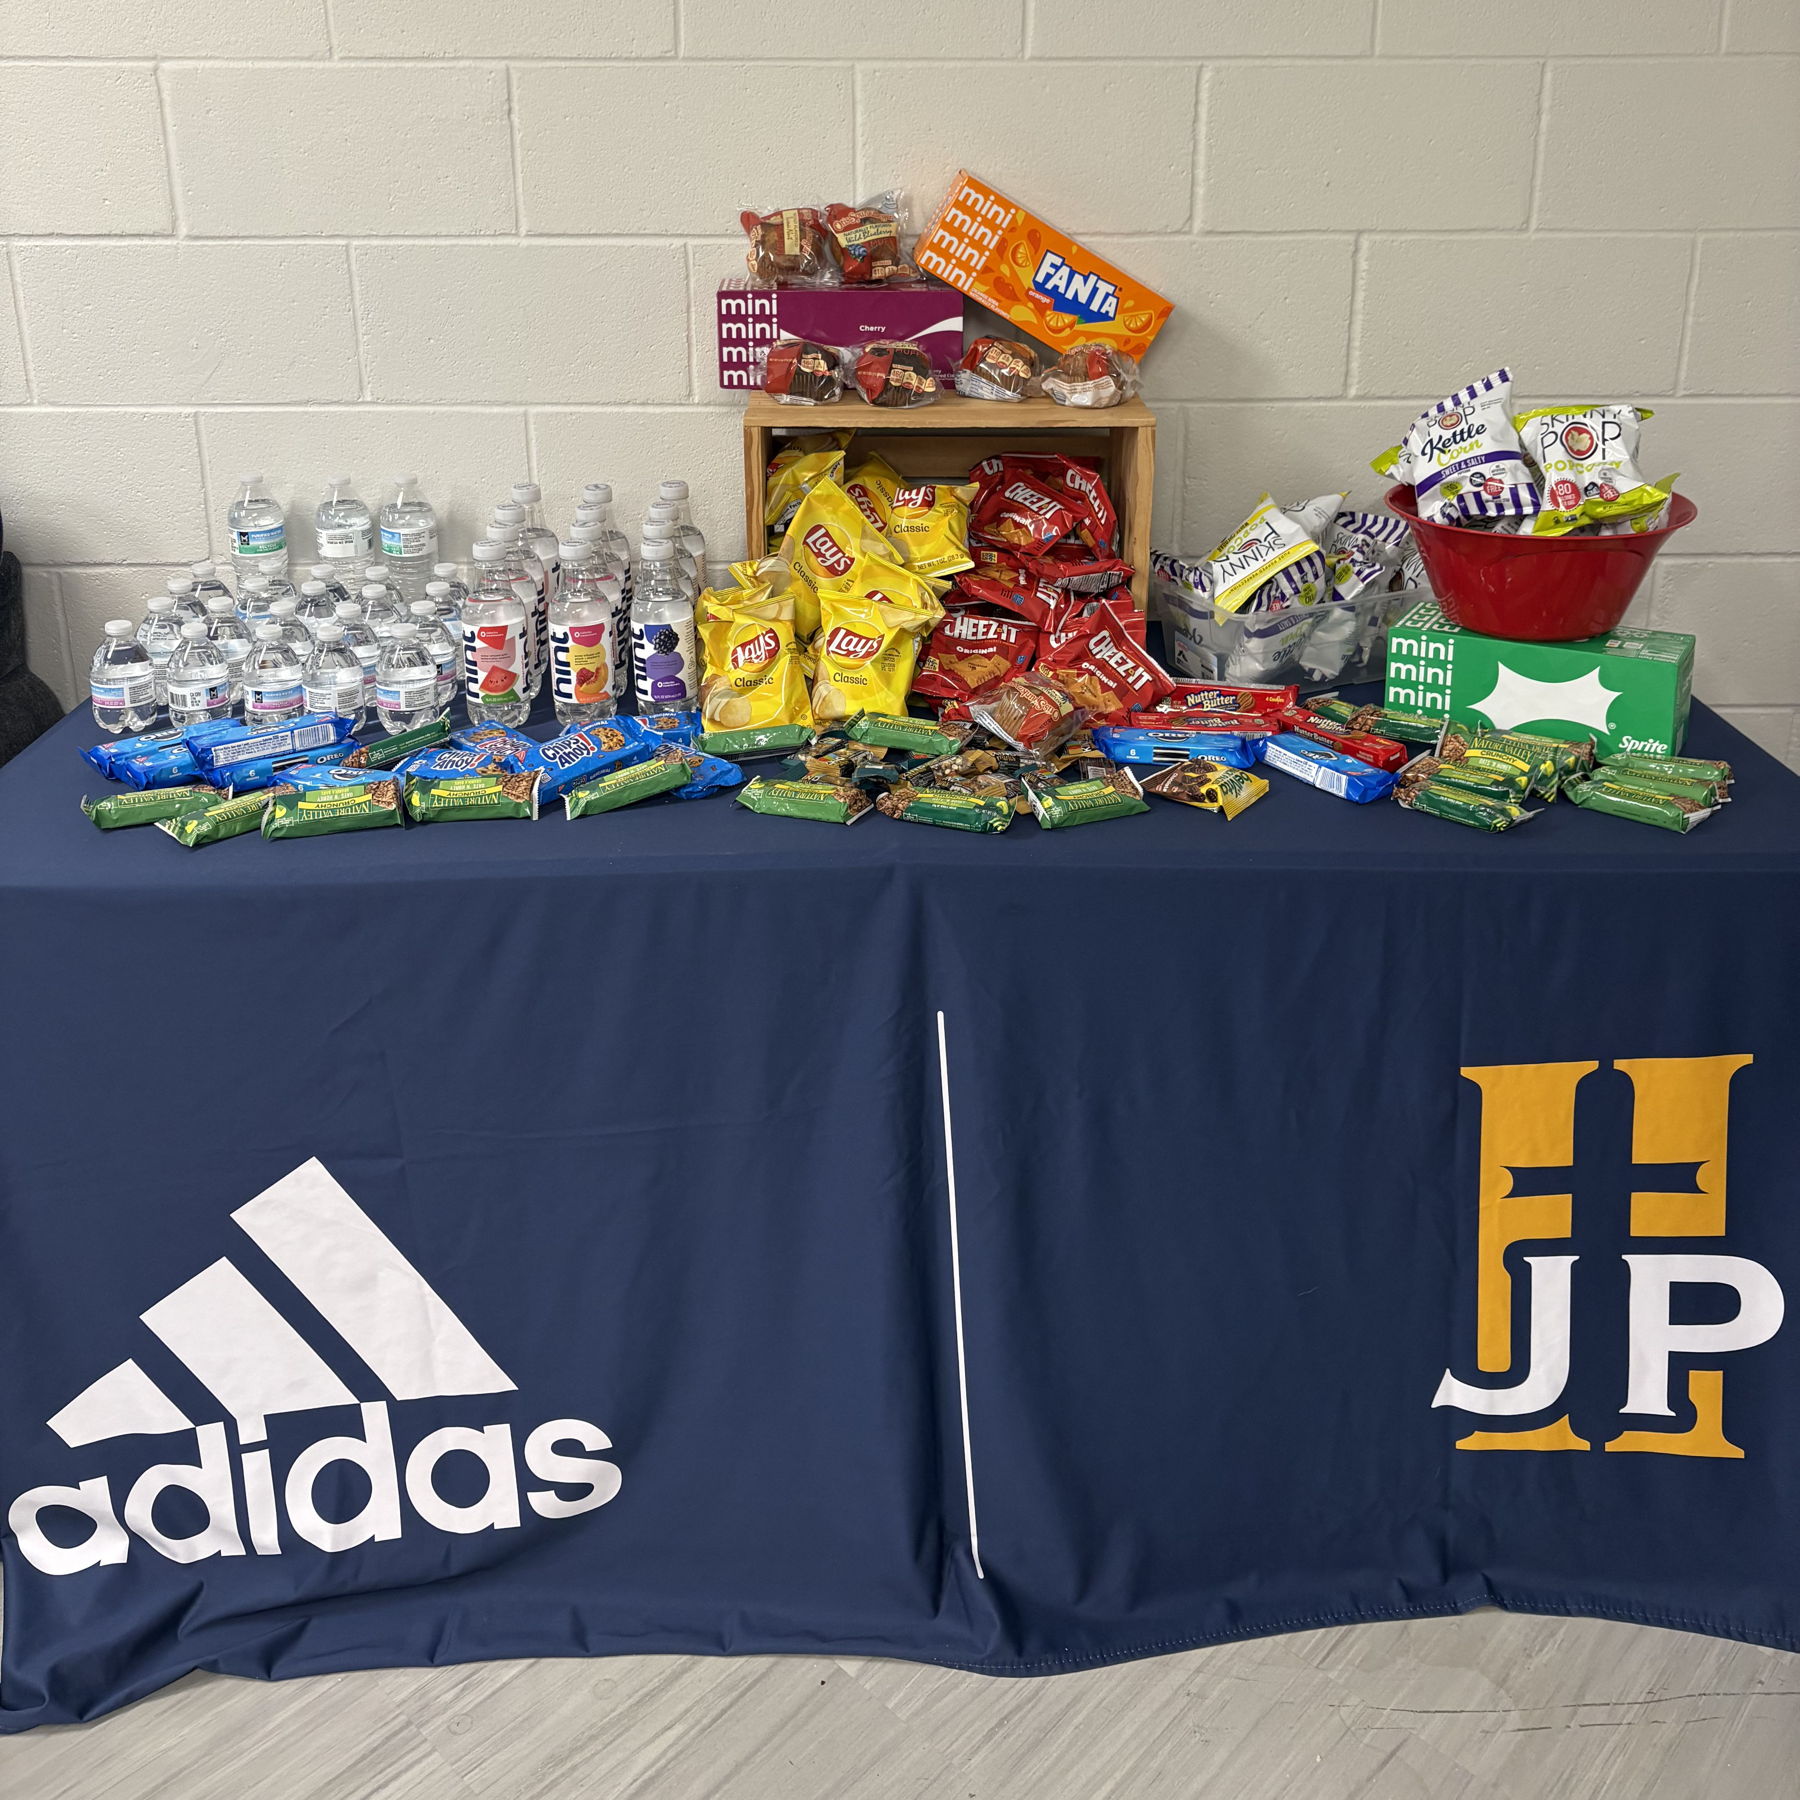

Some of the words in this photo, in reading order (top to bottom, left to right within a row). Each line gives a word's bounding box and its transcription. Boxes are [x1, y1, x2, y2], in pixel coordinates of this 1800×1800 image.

[958, 186, 1015, 228] mini
[945, 207, 1003, 250] mini
[932, 229, 990, 271] mini
[920, 250, 977, 292] mini
[1034, 251, 1118, 318] FANTA
[721, 293, 777, 315] mini
[1028, 290, 1051, 304] orange
[722, 318, 778, 339] mini
[859, 324, 886, 333] Cherry
[1421, 424, 1487, 463] Kettle
[1437, 439, 1483, 467] Corn
[1441, 463, 1460, 478] SWEET
[1467, 456, 1486, 467] SALTY
[893, 524, 930, 534] Classic
[805, 527, 851, 571] Lay's
[1220, 536, 1286, 583] SKINNY
[793, 561, 819, 594] Classic
[731, 632, 776, 667] Lay's
[828, 628, 882, 658] Lay's
[1391, 635, 1455, 661] mini
[463, 629, 480, 699] hint
[551, 628, 573, 699] hint
[1390, 660, 1453, 686] mini
[734, 676, 774, 687] Classic
[833, 672, 868, 686] Classic
[1081, 662, 1118, 689] ORIGINAL
[1187, 690, 1221, 705] Nutter
[1202, 696, 1237, 711] Butter
[1388, 685, 1452, 711] mini
[1307, 716, 1342, 728] Nutter
[541, 734, 580, 762] Chips
[558, 732, 597, 769] Ahoy!
[1471, 736, 1502, 750] NATURE
[1503, 742, 1534, 762] VALLEY
[1619, 735, 1669, 754] Sprite
[316, 752, 344, 764] OREO
[1198, 755, 1227, 763] OREO
[1480, 750, 1516, 764] CRUNCHY
[249, 769, 255, 777] 6
[446, 789, 487, 797] CRUNCHY
[768, 789, 798, 798] VALLEY
[799, 790, 827, 801] NATURE
[1219, 771, 1253, 798] belVita
[120, 795, 154, 805] VALLEY
[155, 790, 190, 802] NATURE
[314, 799, 356, 809] CRUNCHY
[433, 797, 462, 807] VALLEY
[464, 794, 499, 806] NATURE
[1068, 799, 1094, 812] VALLEY
[1095, 793, 1122, 807] NATURE
[214, 805, 252, 822] VALLEY
[300, 809, 333, 822] VALLEY
[334, 803, 370, 816] NATURE
[8, 1401, 622, 1575] adidas
